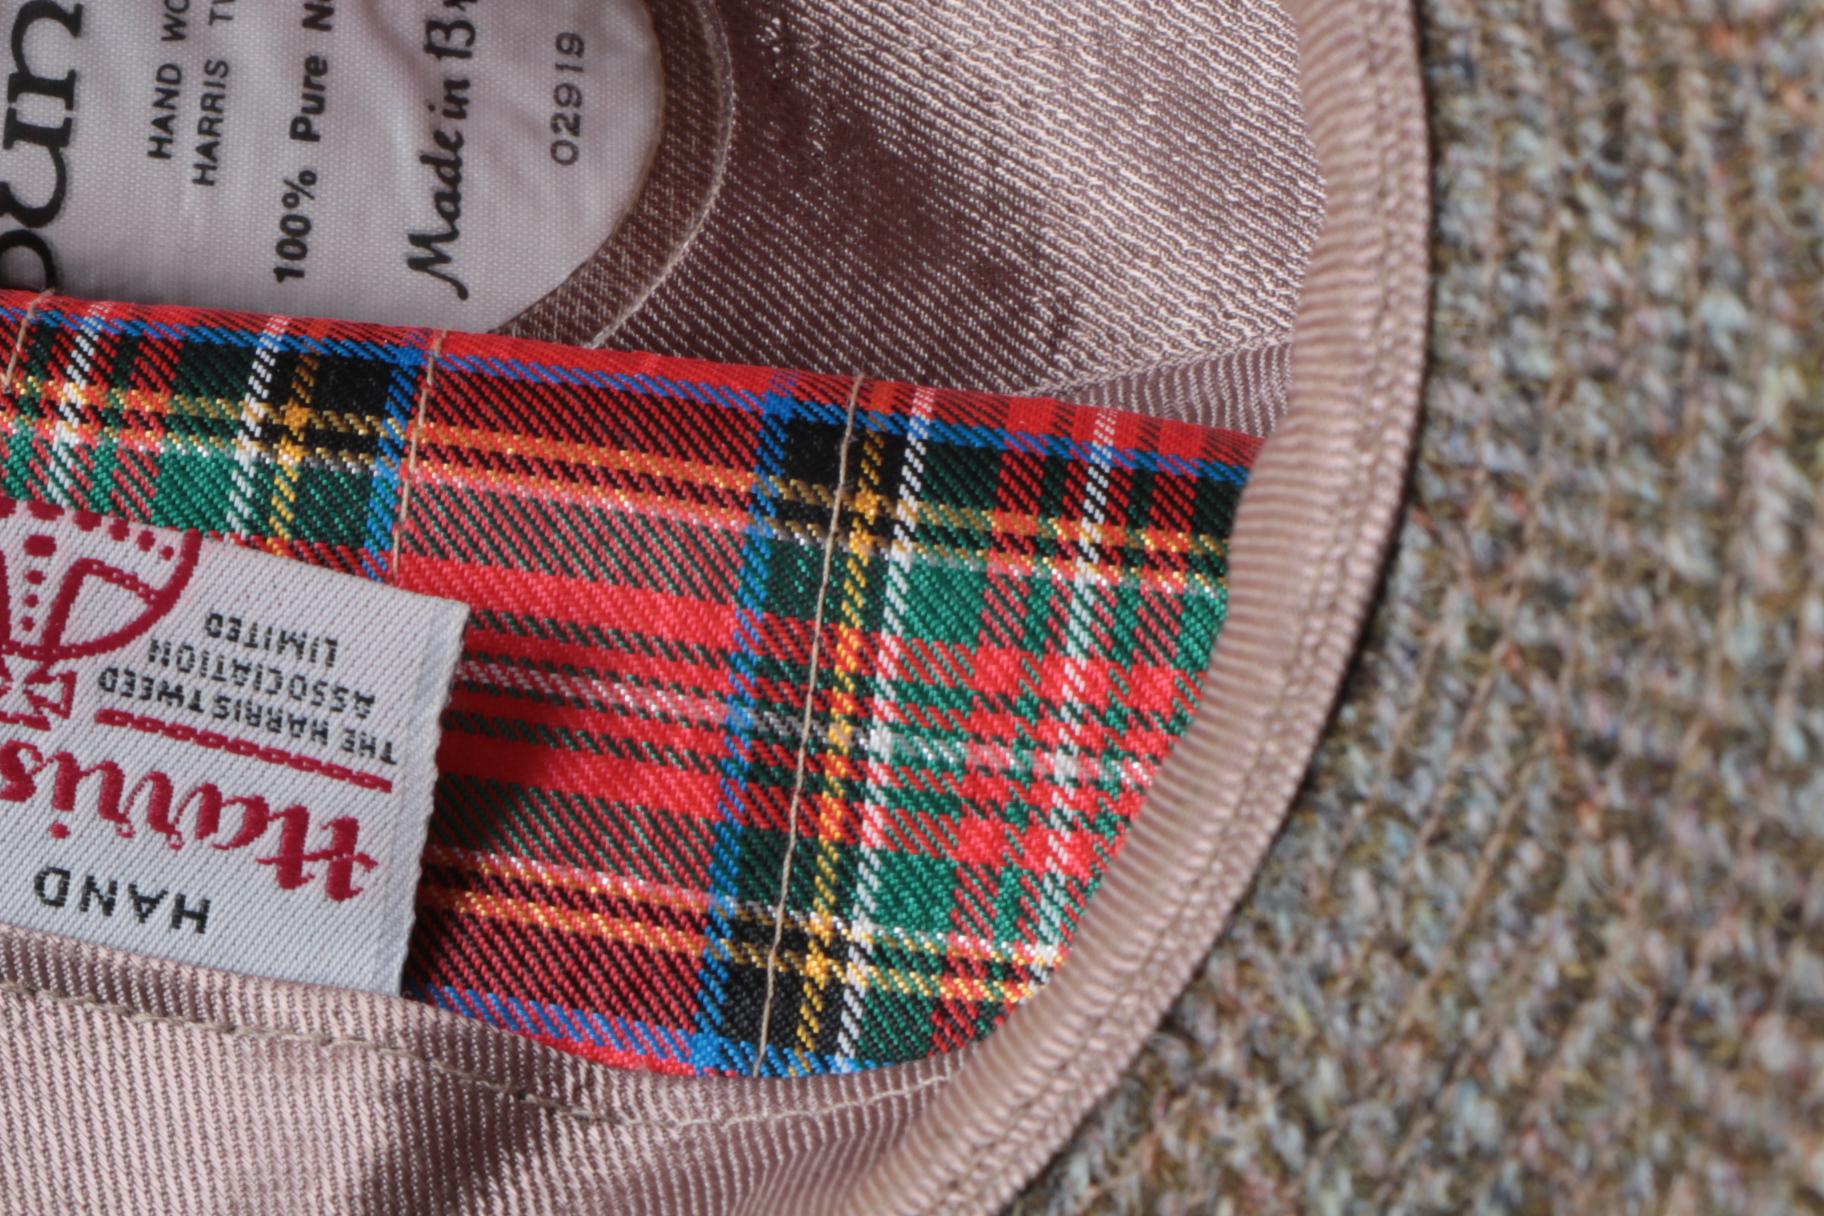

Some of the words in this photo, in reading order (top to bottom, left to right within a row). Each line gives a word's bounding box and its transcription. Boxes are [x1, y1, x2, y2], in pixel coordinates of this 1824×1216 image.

[147, 62, 184, 160] HAND
[192, 58, 231, 187] HARRIS
[289, 54, 329, 144] Pure
[428, 76, 472, 122] in
[550, 31, 586, 167] 02919
[274, 167, 318, 284] 100%
[406, 127, 469, 302] Made
[147, 638, 377, 720] ASSOCIATION
[204, 611, 339, 668] LIMITED
[98, 667, 204, 712] TWEED
[212, 694, 329, 746] HARRIS
[341, 727, 398, 766] THE
[34, 866, 212, 935] HAND
